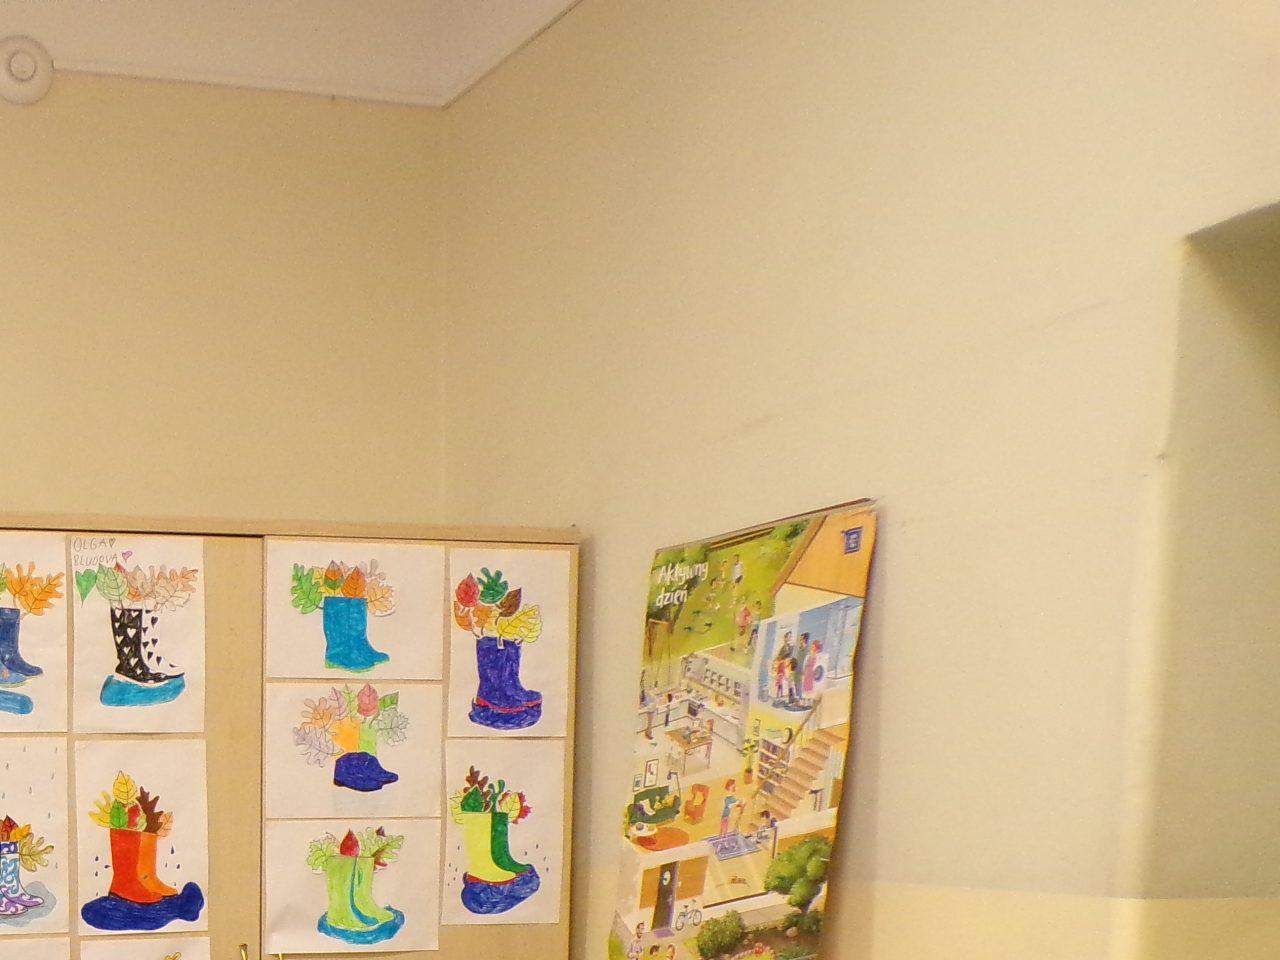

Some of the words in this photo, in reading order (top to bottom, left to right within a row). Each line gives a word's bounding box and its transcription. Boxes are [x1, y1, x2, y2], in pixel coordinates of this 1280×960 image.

[73, 537, 107, 552] OLGA
[658, 562, 709, 585] Aktywny
[655, 585, 688, 608] dzień
